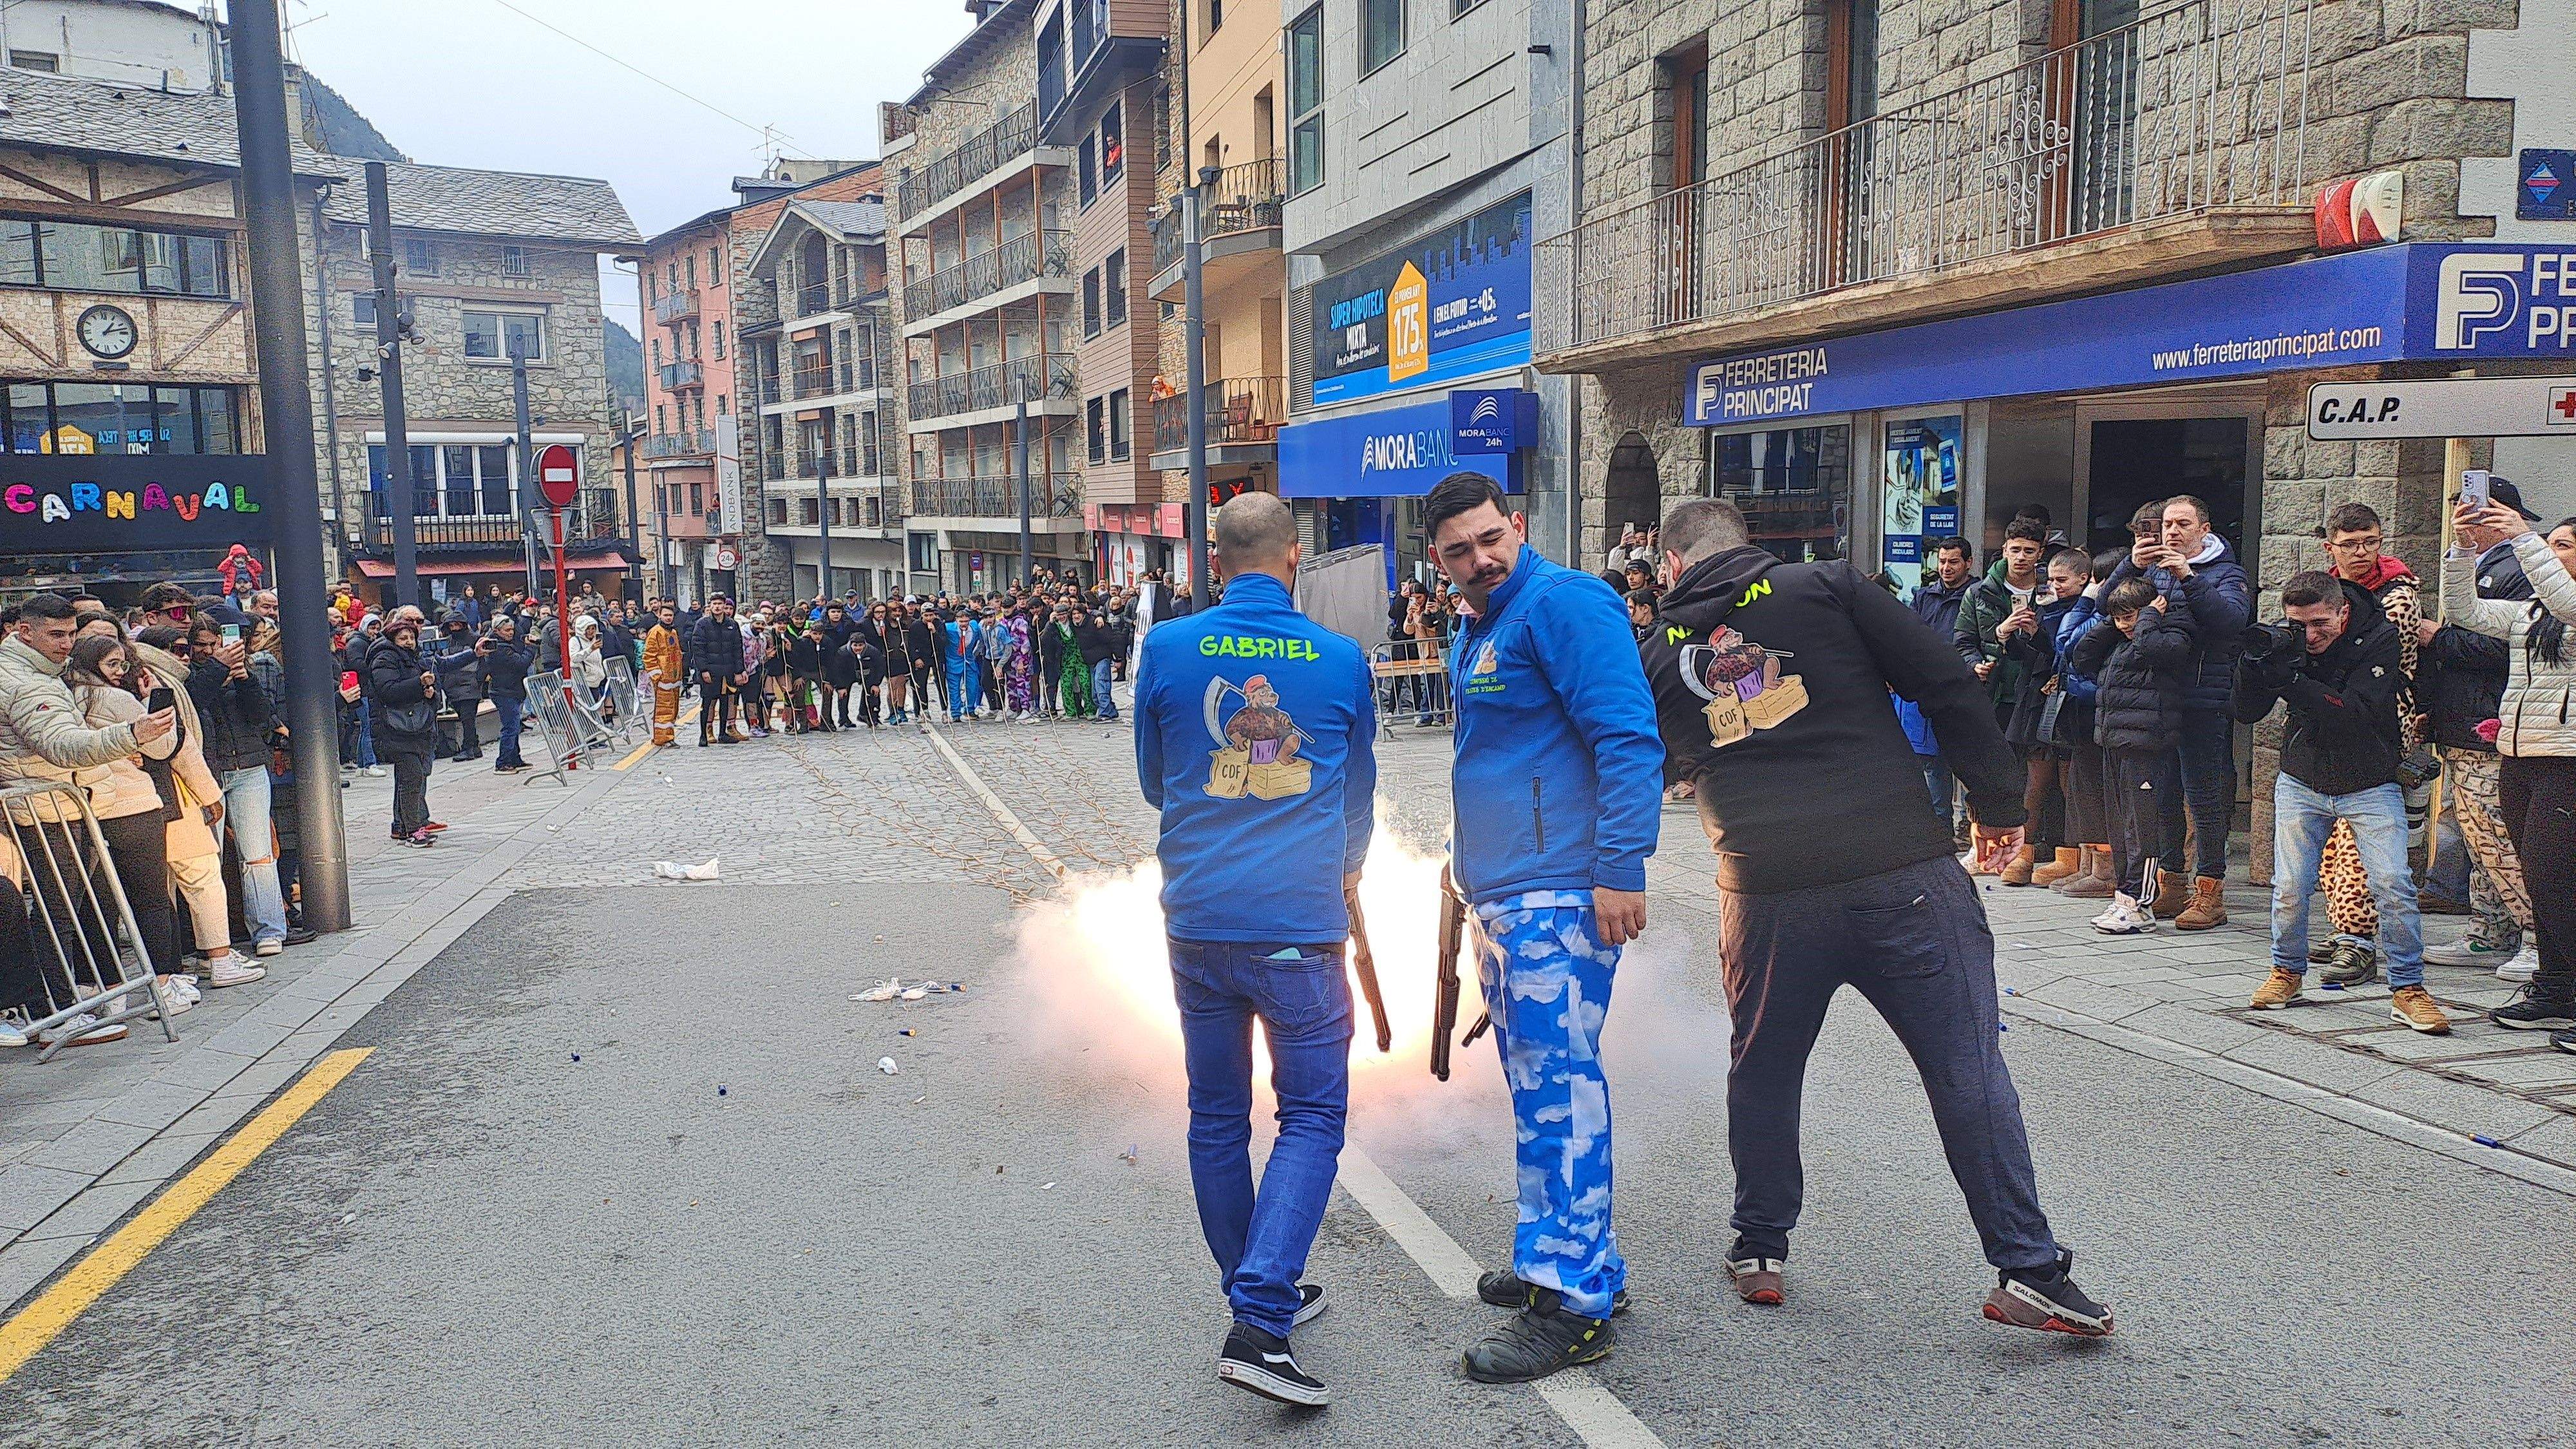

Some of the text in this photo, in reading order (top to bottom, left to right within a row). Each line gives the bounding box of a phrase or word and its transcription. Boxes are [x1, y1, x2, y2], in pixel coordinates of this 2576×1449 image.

[1352, 288, 1384, 322] HIPOTECA
[1450, 298, 1468, 320] FUTUR
[1346, 323, 1367, 352] MIXTA
[2152, 326, 2381, 370] www.ferreteriaprincipat.com
[1725, 346, 1828, 388] FERRETERIA
[1723, 382, 1814, 418] PRINCIPAT
[2318, 397, 2400, 424] C.A.P.
[1459, 427, 1510, 437] MORABANC
[1485, 438, 1502, 447] 24h
[4, 482, 261, 523] CARNAVAL
[726, 470, 737, 531] ANDBANK
[1199, 635, 1320, 661] GABRIEL
[1719, 708, 1738, 727] CDF
[1222, 764, 1242, 779] CDF
[2012, 1285, 2052, 1310] SALOMON
